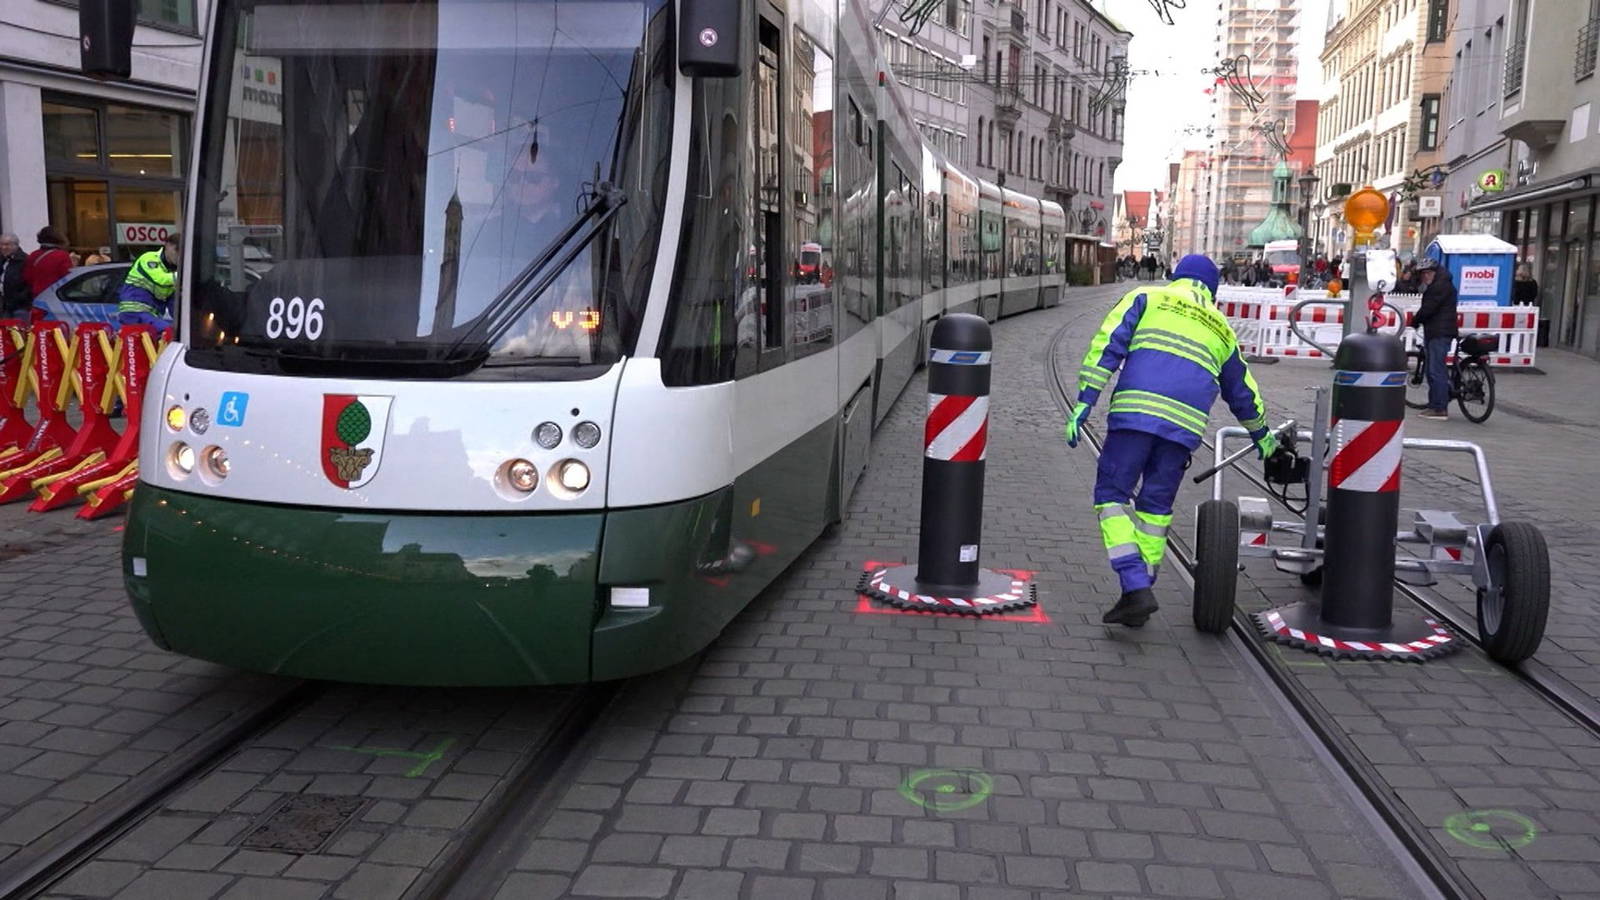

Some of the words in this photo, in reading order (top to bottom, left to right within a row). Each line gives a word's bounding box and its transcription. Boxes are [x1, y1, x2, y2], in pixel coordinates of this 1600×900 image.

[1465, 268, 1495, 279] mobi
[266, 296, 325, 341] 896
[39, 330, 48, 381] PITAGONE
[84, 332, 92, 382] PITAGONE
[127, 335, 137, 387] PITAGONE
